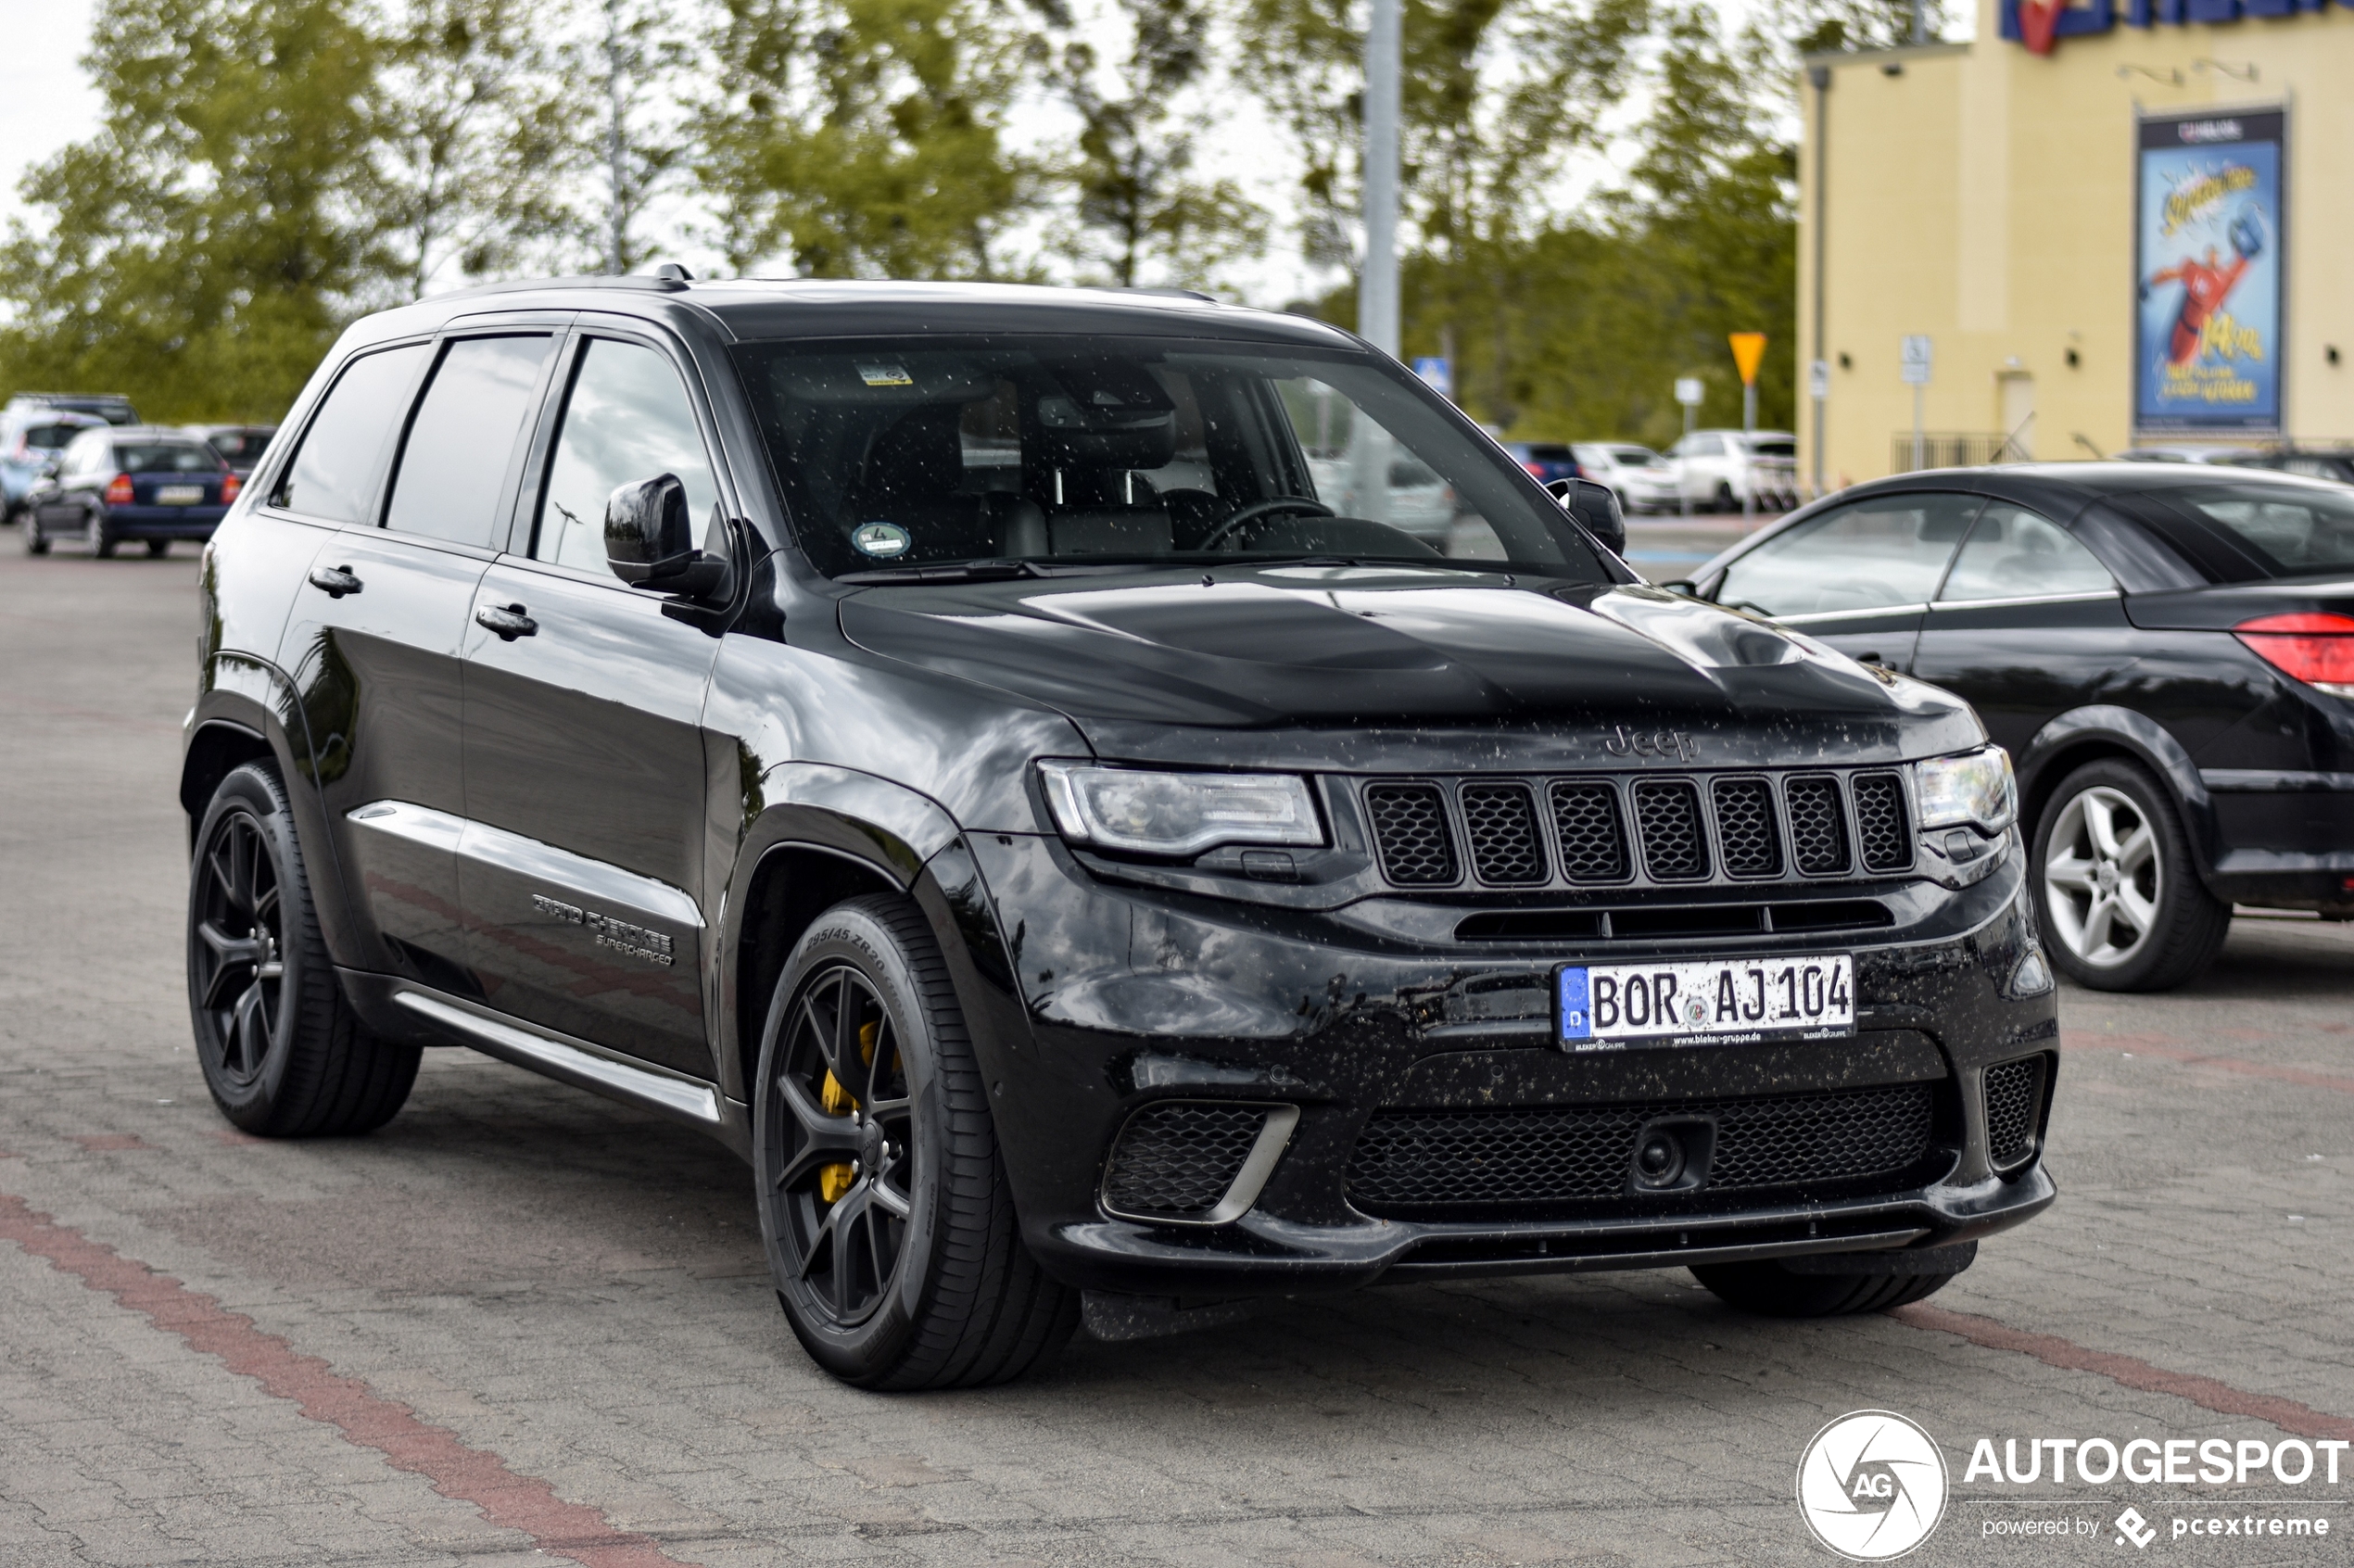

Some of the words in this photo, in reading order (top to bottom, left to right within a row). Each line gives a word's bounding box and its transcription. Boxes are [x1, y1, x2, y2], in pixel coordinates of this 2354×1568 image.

[874, 527, 887, 539] 4
[1606, 725, 1701, 762] Jeep
[532, 893, 584, 924] GRAND
[587, 911, 675, 953] CHEROKEE
[596, 934, 676, 966] SUPERCHARGED
[805, 928, 851, 952] 295/45
[851, 934, 885, 971] ZR20
[1593, 972, 1679, 1028] BOR
[1569, 1011, 1581, 1028] D
[1576, 1043, 1596, 1051] BLEKER
[1673, 1031, 1761, 1044] www.bleker-gruppe.de
